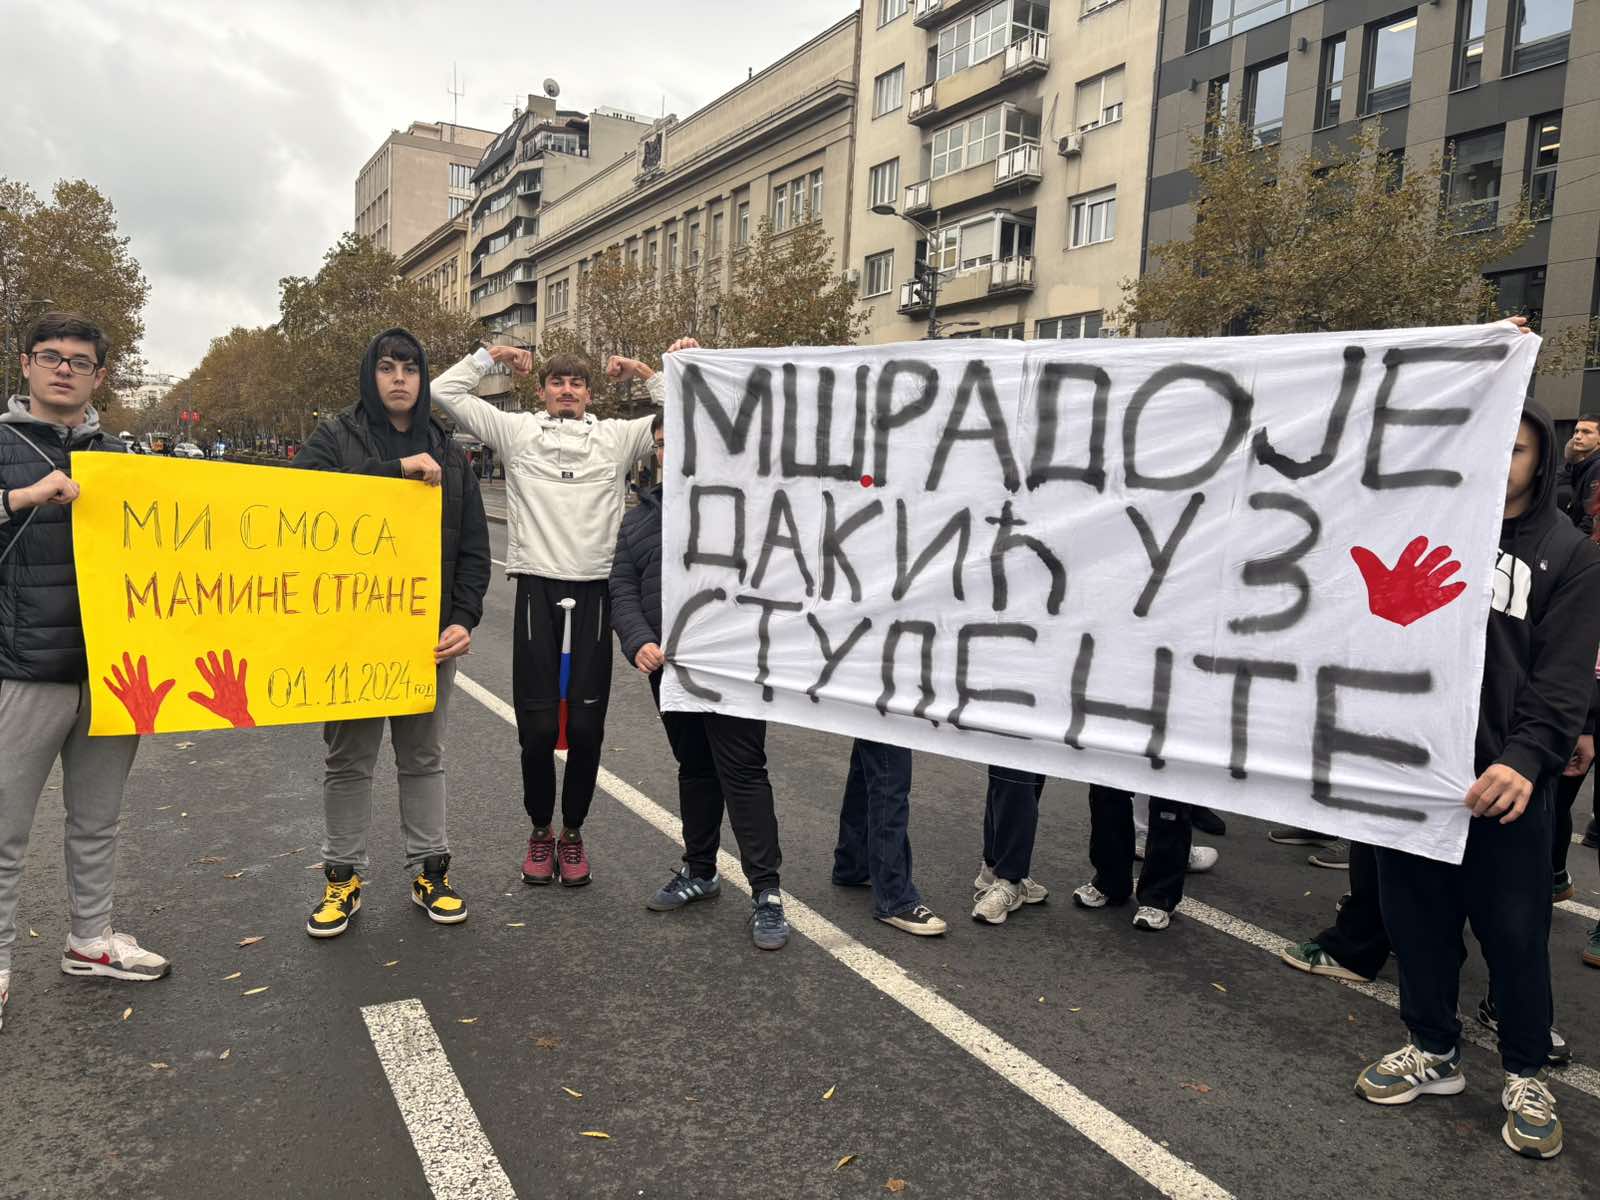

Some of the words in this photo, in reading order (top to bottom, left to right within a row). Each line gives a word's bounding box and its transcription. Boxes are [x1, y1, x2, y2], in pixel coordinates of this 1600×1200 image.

[123, 500, 212, 551] МИ
[240, 504, 340, 552] СМО
[351, 513, 398, 556] СА
[683, 484, 1067, 615] ДАКИЋ
[124, 571, 303, 623] МАМИНЕ
[313, 571, 429, 616] СТРАНЕ
